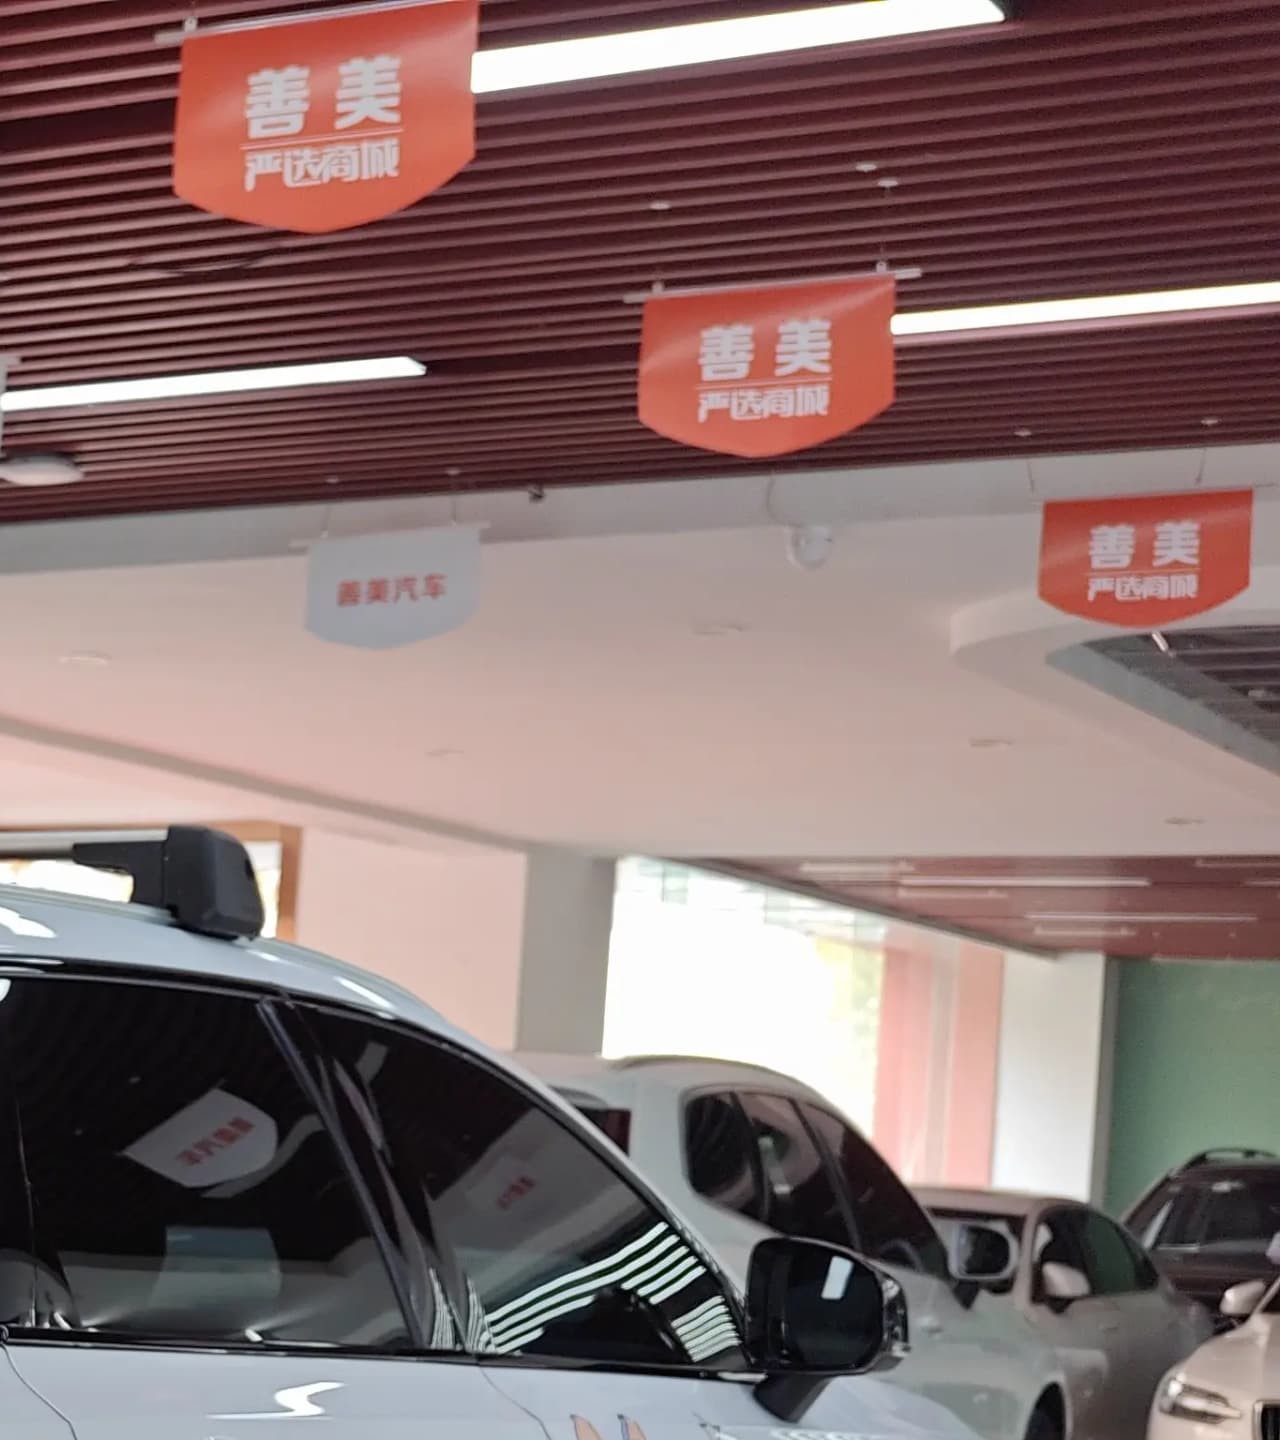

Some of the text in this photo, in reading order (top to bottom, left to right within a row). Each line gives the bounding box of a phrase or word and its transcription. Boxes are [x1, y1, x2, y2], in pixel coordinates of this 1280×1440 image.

[245, 53, 402, 139] 善美
[244, 138, 400, 192] 严选商城
[698, 319, 832, 381] 善美
[698, 384, 829, 423] 严选商城
[1089, 519, 1200, 569] 善美
